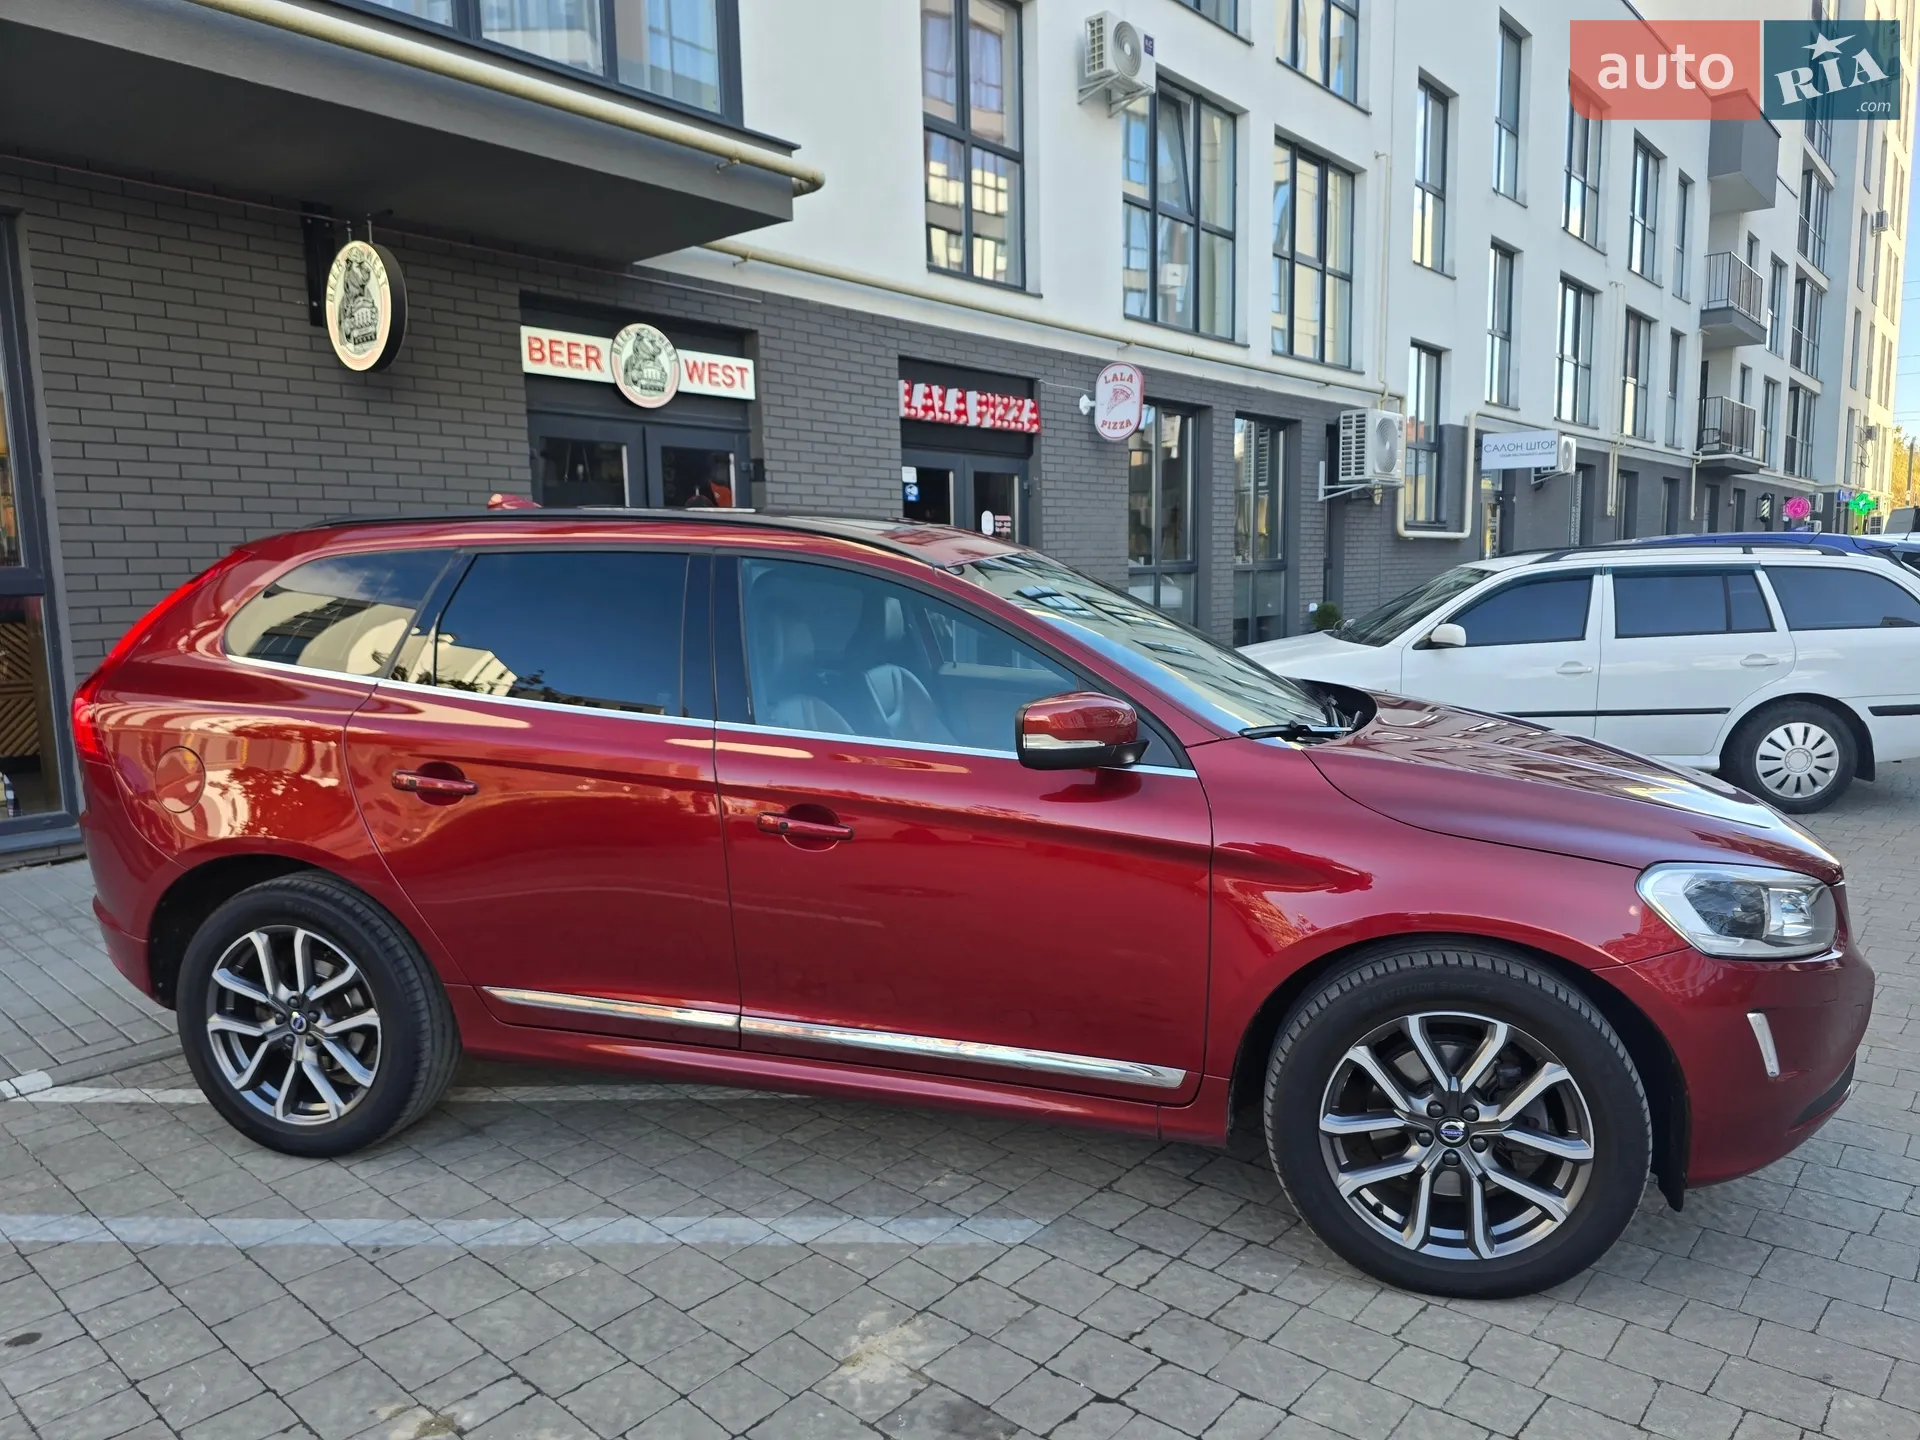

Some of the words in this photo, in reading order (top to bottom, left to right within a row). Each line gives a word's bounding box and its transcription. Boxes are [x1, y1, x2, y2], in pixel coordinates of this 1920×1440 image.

[527, 335, 605, 373] BEER
[684, 358, 749, 390] WEST
[1104, 372, 1134, 384] LALA
[898, 380, 967, 425] LALA
[966, 390, 1041, 434] PIZZA
[1100, 418, 1132, 430] PIZZA
[1483, 442, 1523, 453] САЛОН
[1525, 440, 1557, 451] ШТОР
